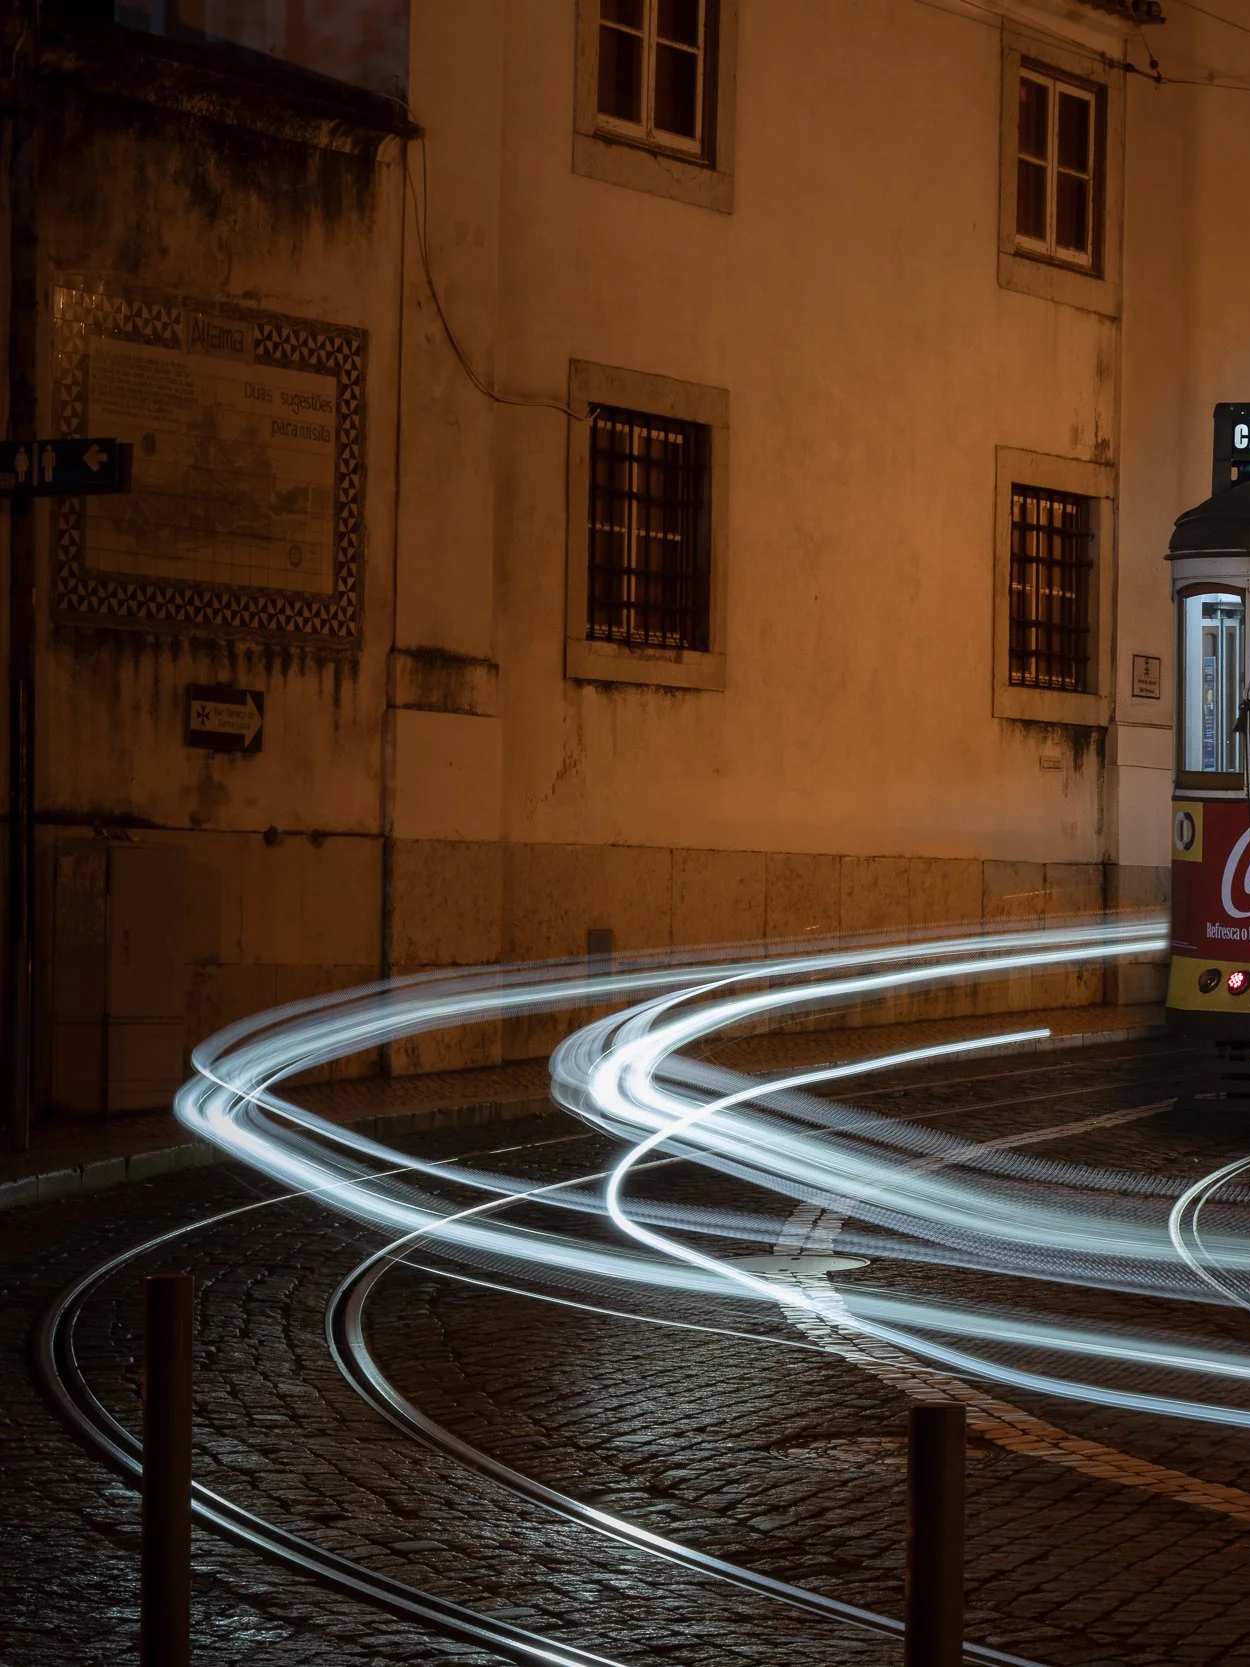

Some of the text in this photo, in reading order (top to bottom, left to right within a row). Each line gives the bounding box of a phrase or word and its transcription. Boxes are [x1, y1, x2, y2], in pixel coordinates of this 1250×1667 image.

[191, 315, 244, 353] Alfama
[244, 381, 333, 415] Duas sugestões
[271, 420, 298, 438] para
[1206, 922, 1240, 941] Refresca
[1241, 929, 1247, 941] o
